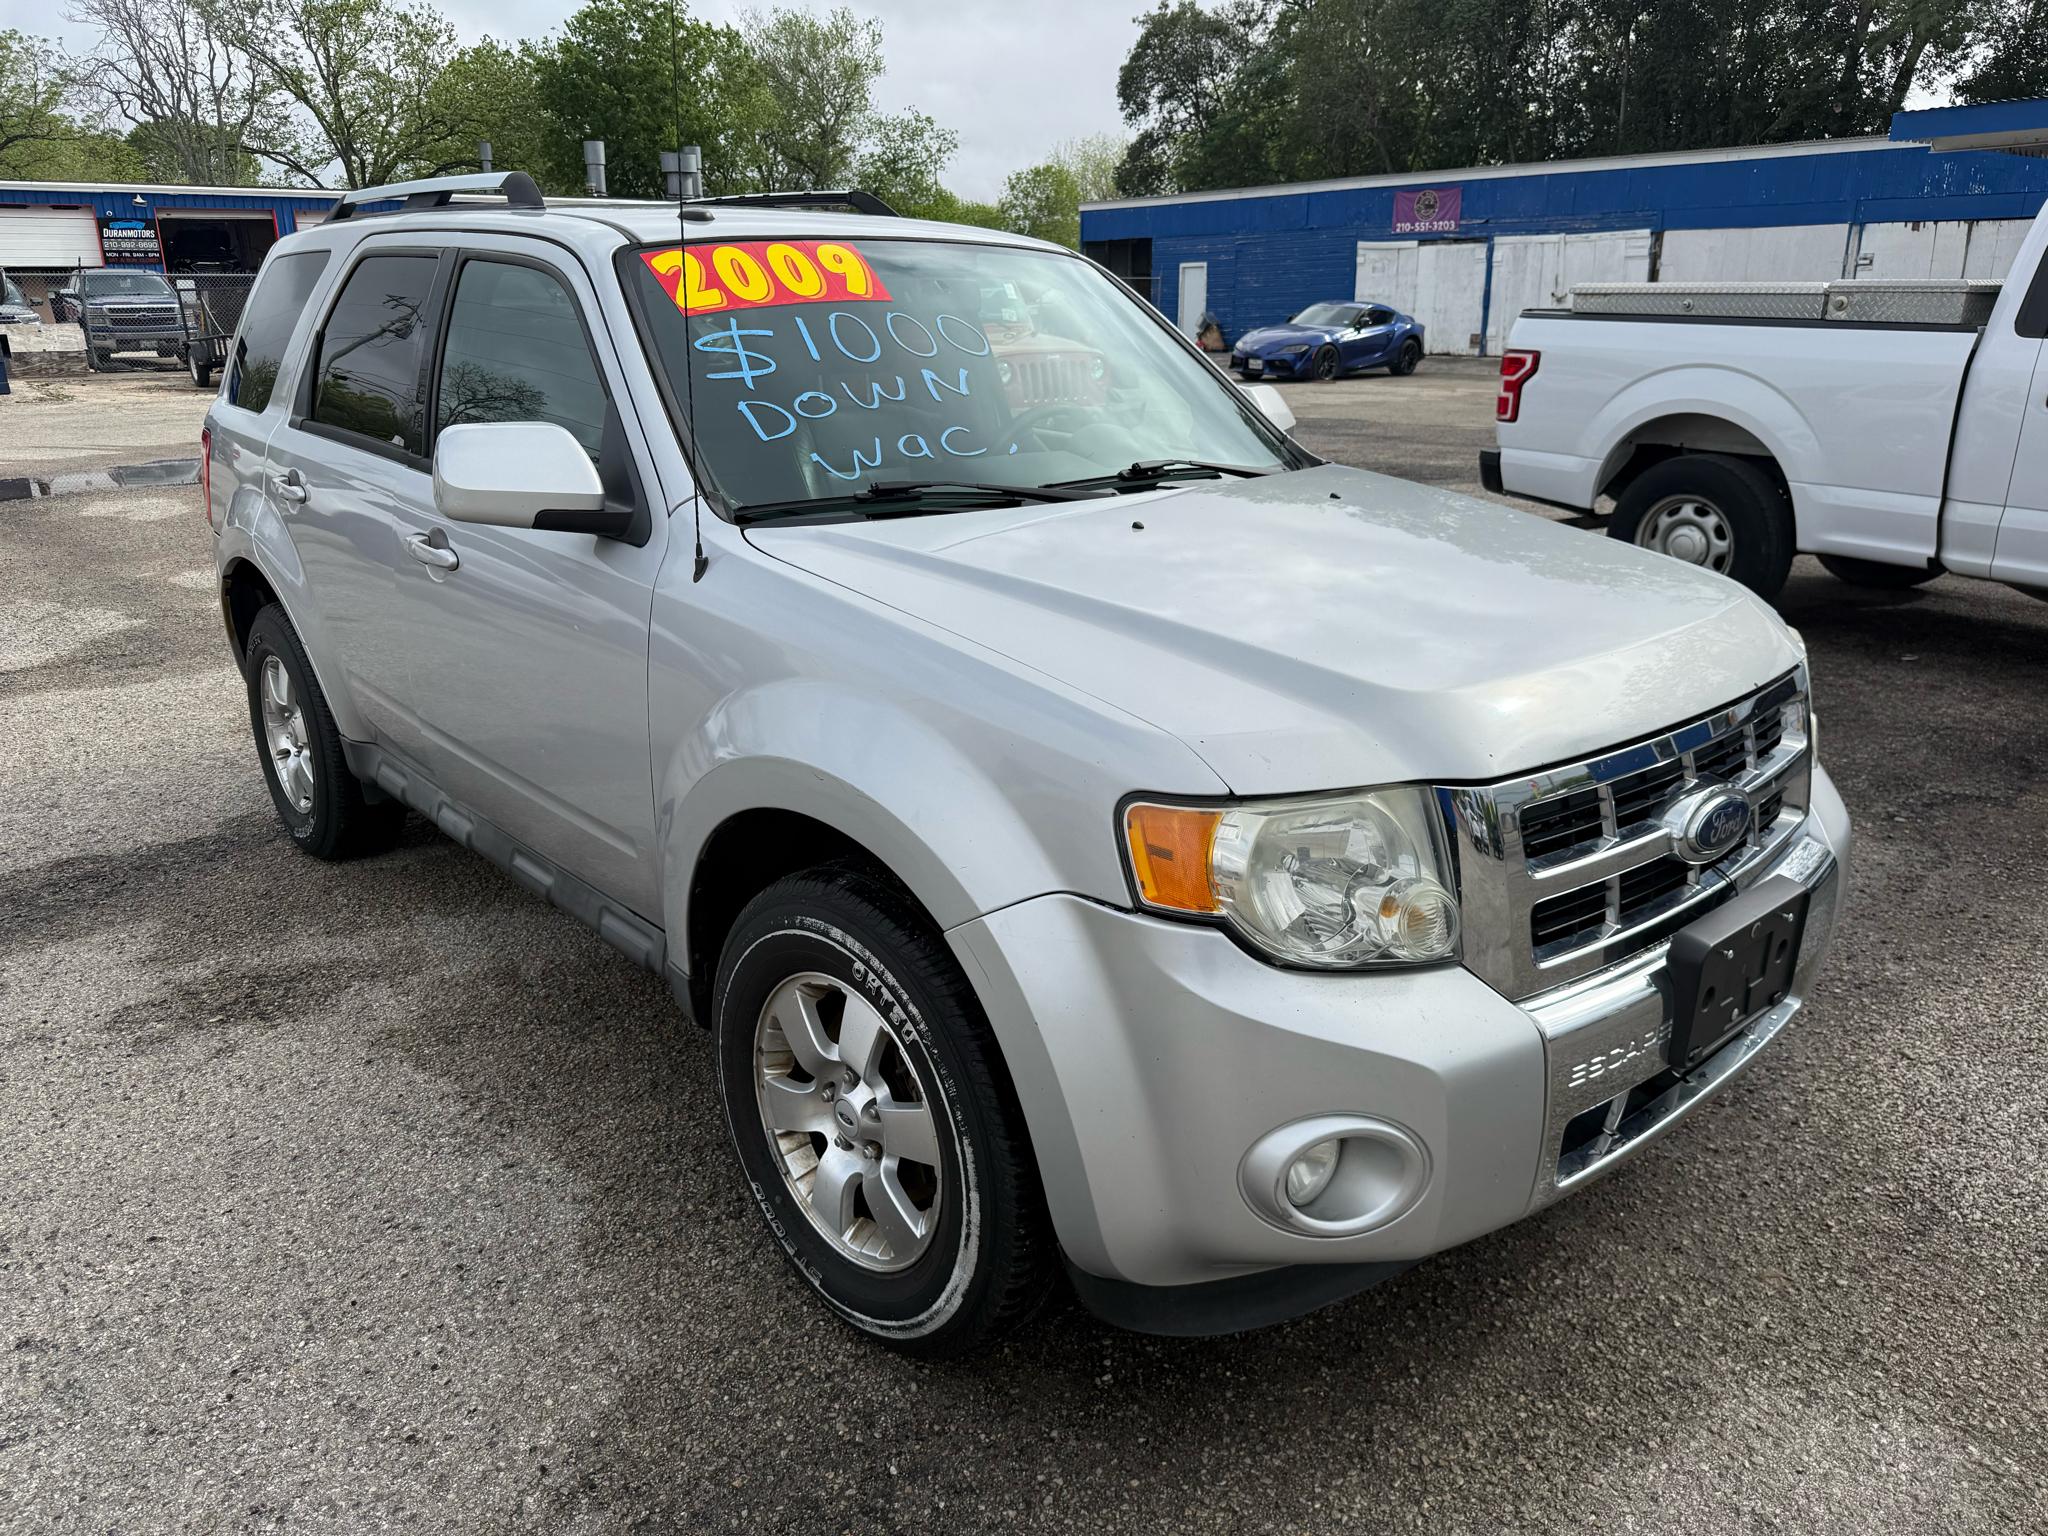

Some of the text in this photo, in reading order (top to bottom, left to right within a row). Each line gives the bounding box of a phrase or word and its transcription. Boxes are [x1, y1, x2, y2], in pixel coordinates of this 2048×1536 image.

[1396, 221, 1456, 232] 210-551-3203
[651, 243, 873, 310] 2009
[694, 312, 991, 390] $1000
[737, 368, 970, 441] DOWN
[1710, 806, 1742, 844] Ford
